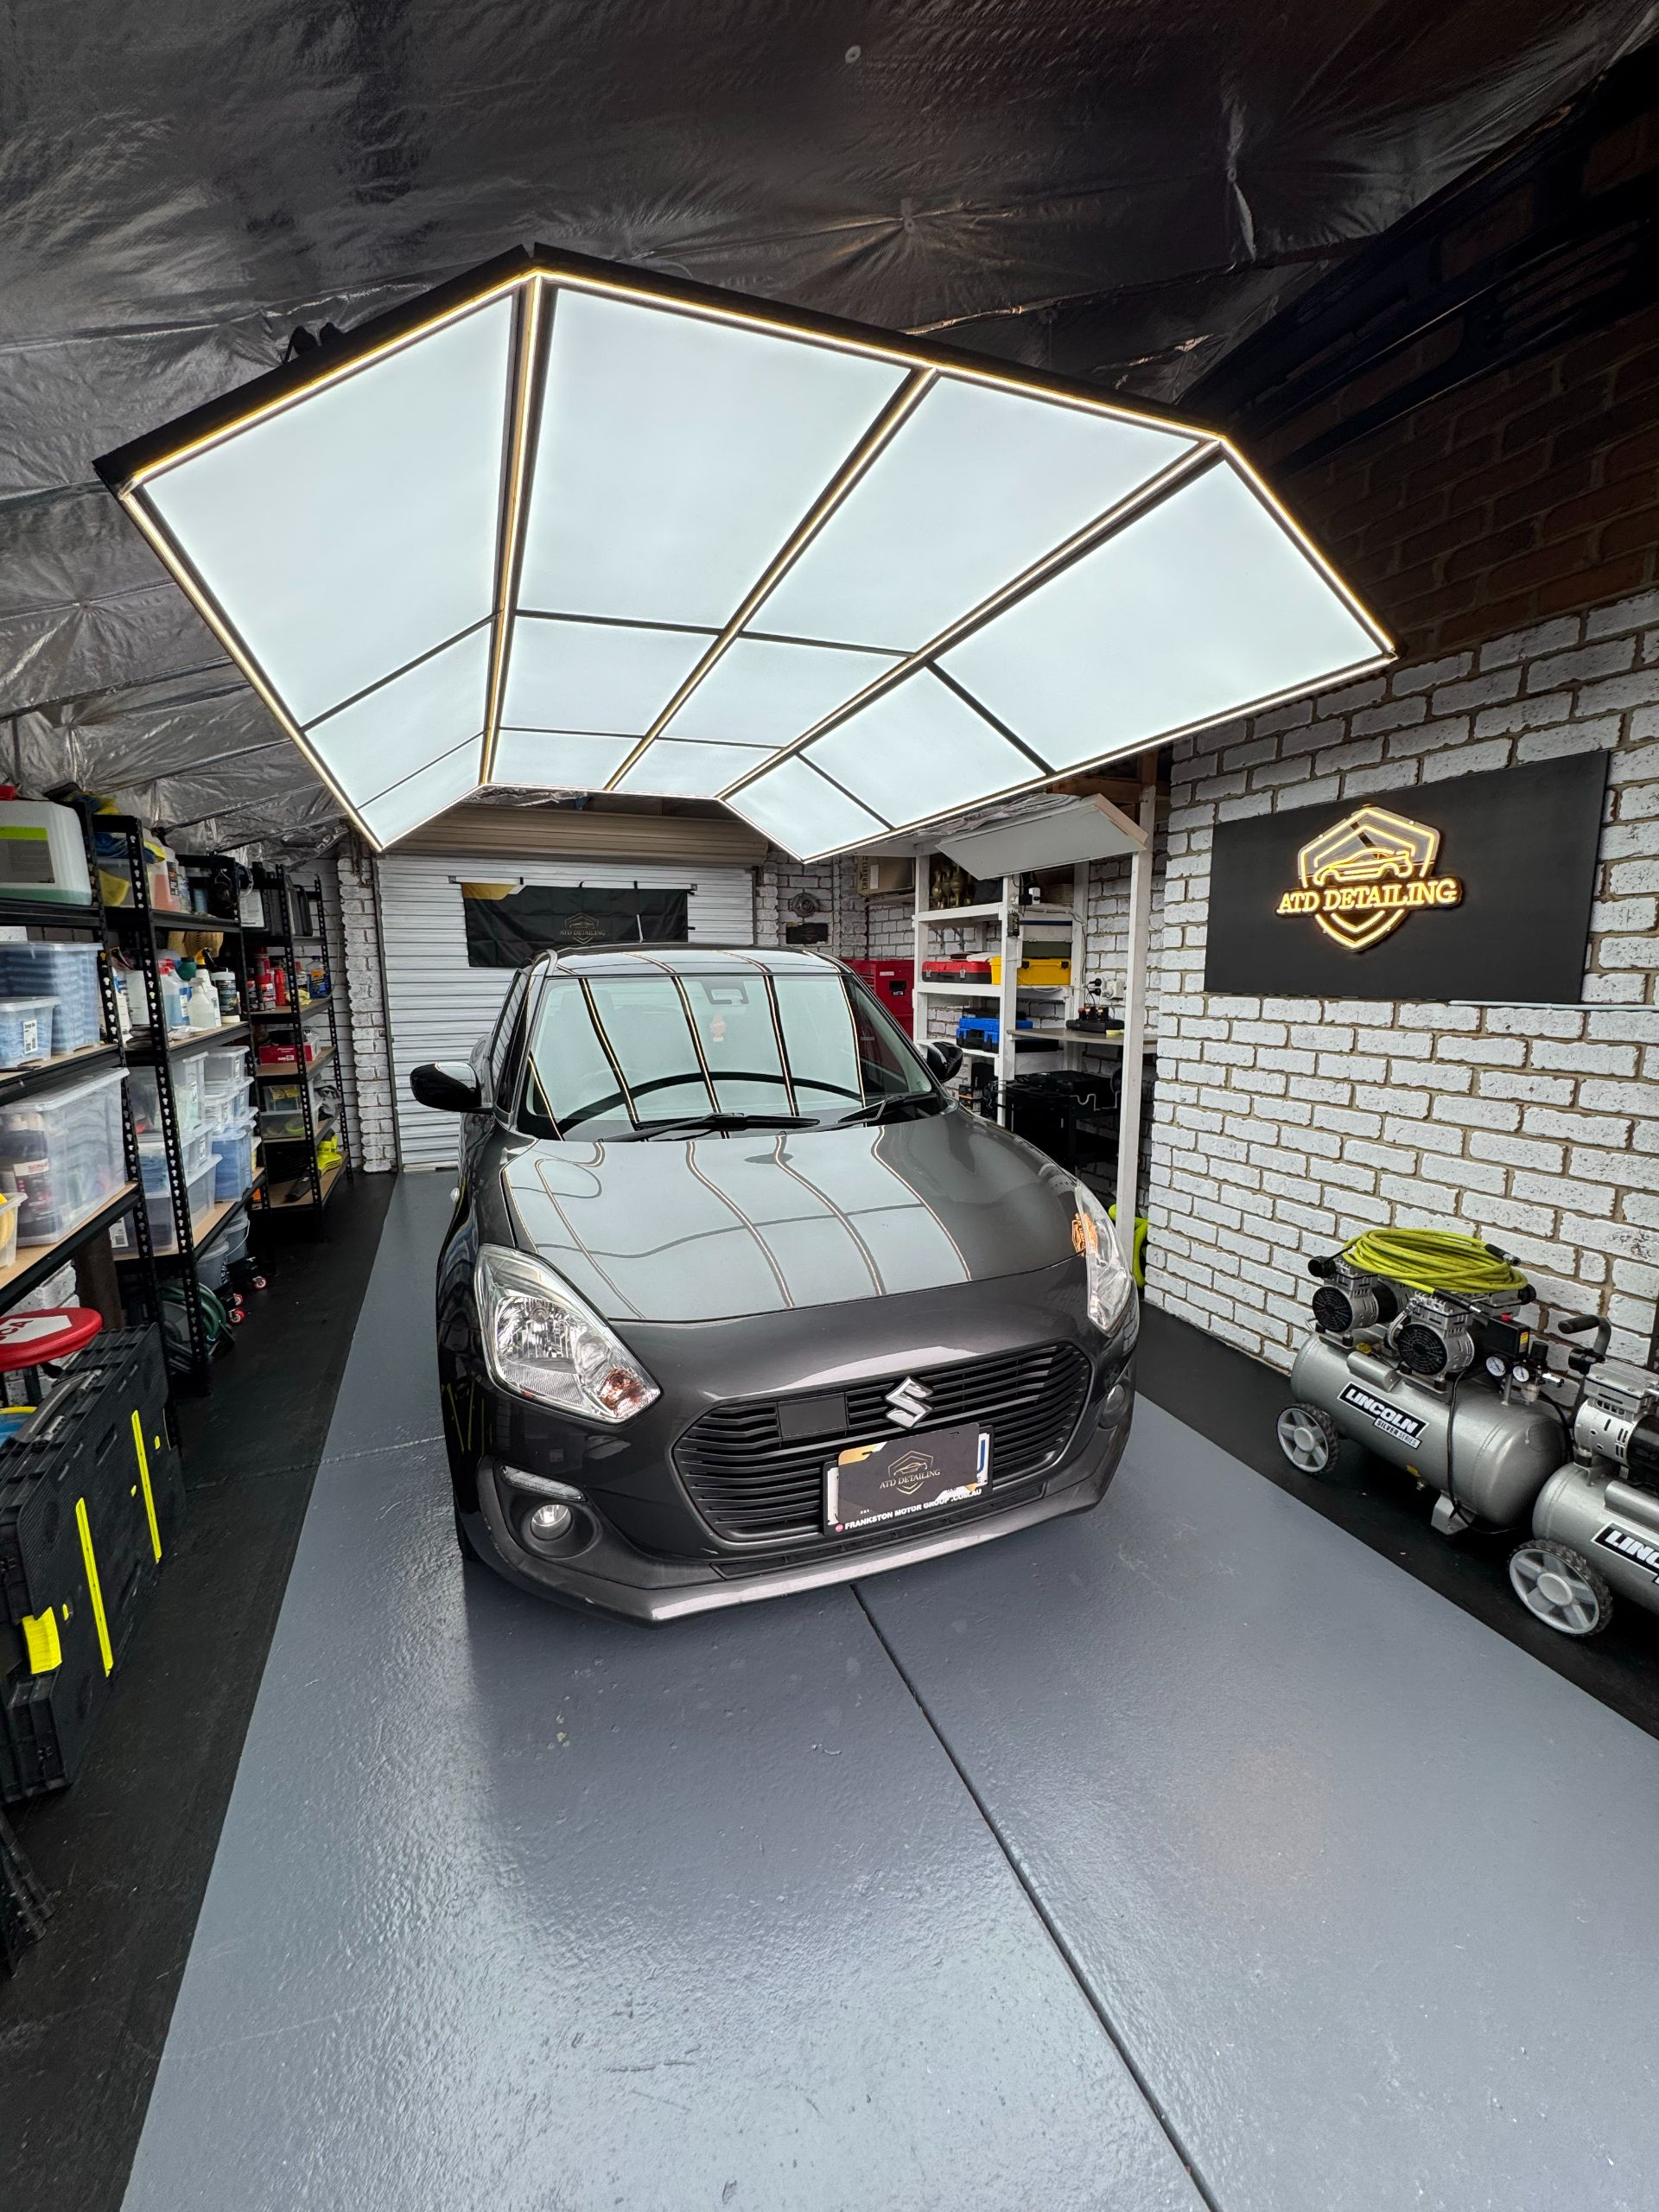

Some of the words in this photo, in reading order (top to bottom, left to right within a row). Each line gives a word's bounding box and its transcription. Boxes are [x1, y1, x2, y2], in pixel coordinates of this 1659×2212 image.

[1276, 891, 1320, 914] ATD
[1322, 877, 1459, 912] DETAILING
[1345, 1388, 1418, 1434] LINCOLN
[1376, 1420, 1399, 1436] SILVER
[1398, 1433, 1417, 1446] SERIES
[879, 1478, 897, 1490] ATD
[898, 1469, 940, 1485] DETAILING
[844, 1511, 893, 1530] FRANKSTON
[894, 1503, 923, 1516] MOTOR
